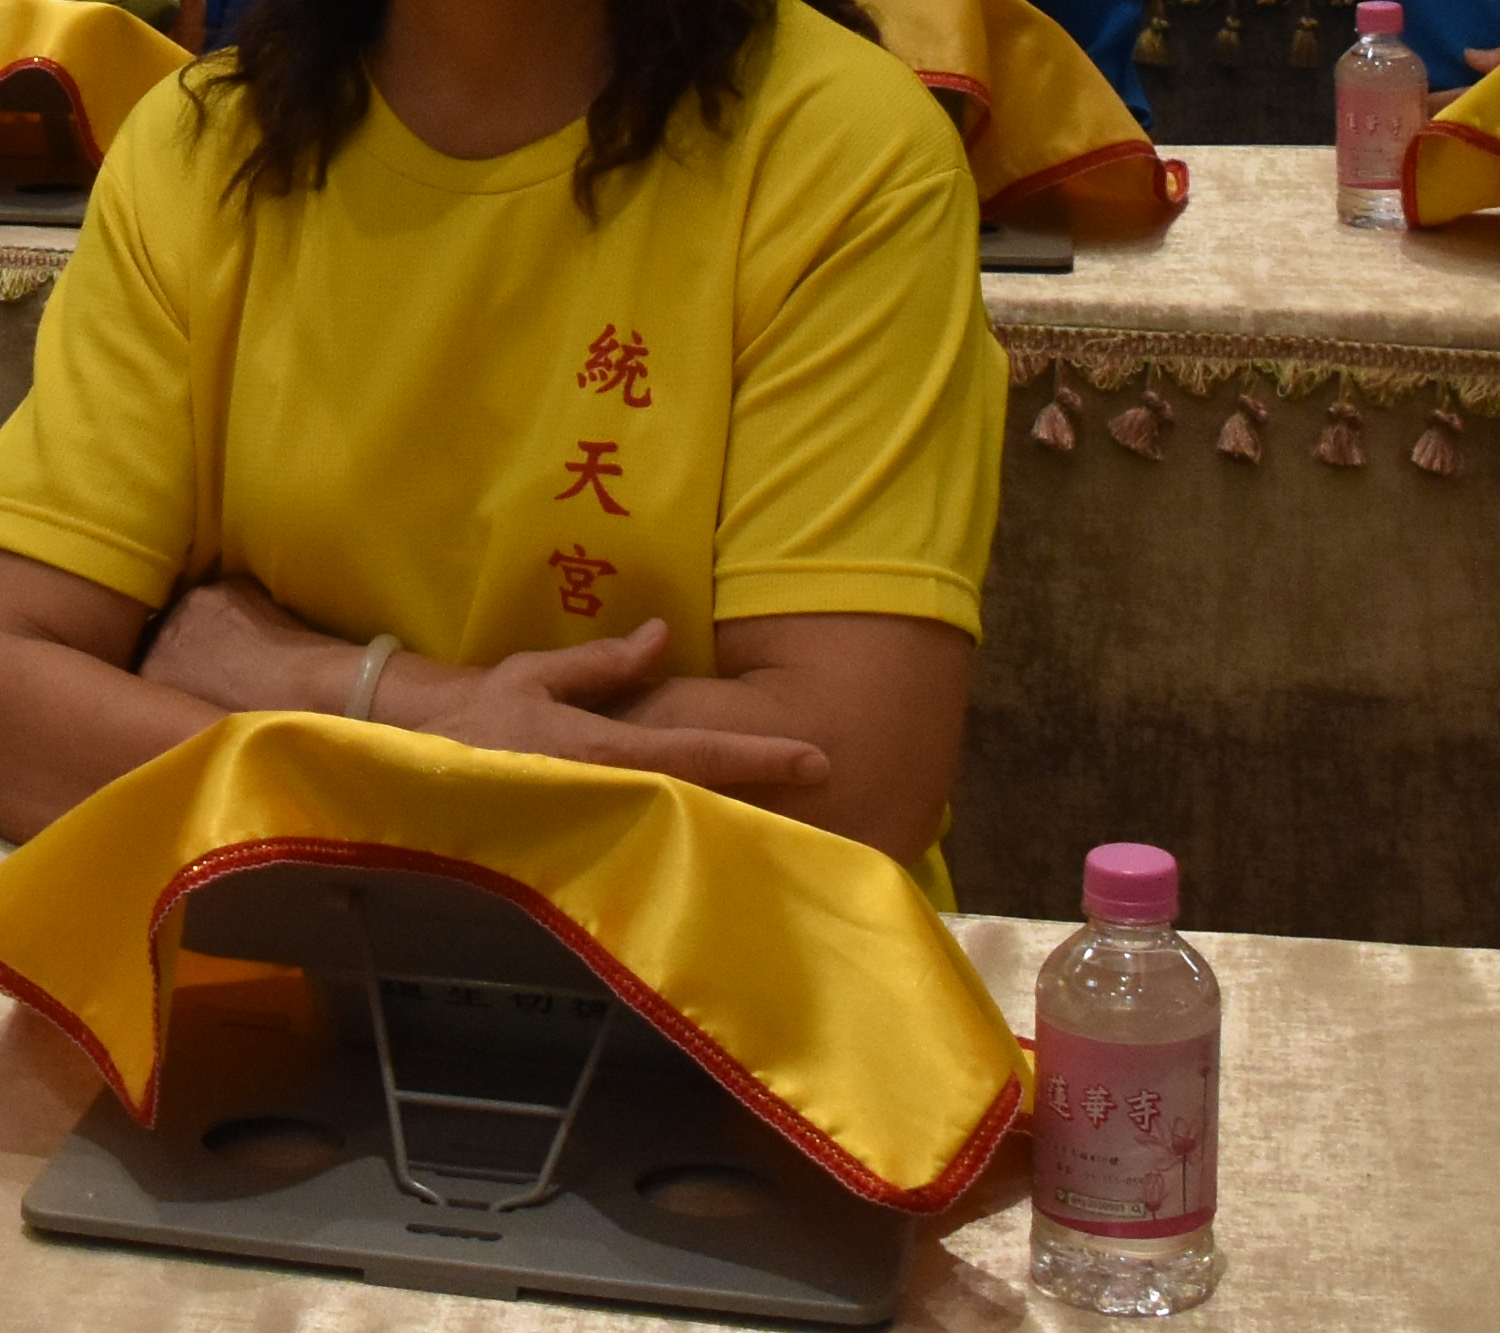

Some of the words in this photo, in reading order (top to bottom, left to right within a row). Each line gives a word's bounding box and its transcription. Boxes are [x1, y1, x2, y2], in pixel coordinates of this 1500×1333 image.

[546, 323, 652, 619] 統天宮
[1047, 1075, 1162, 1134] 蓮華寺
